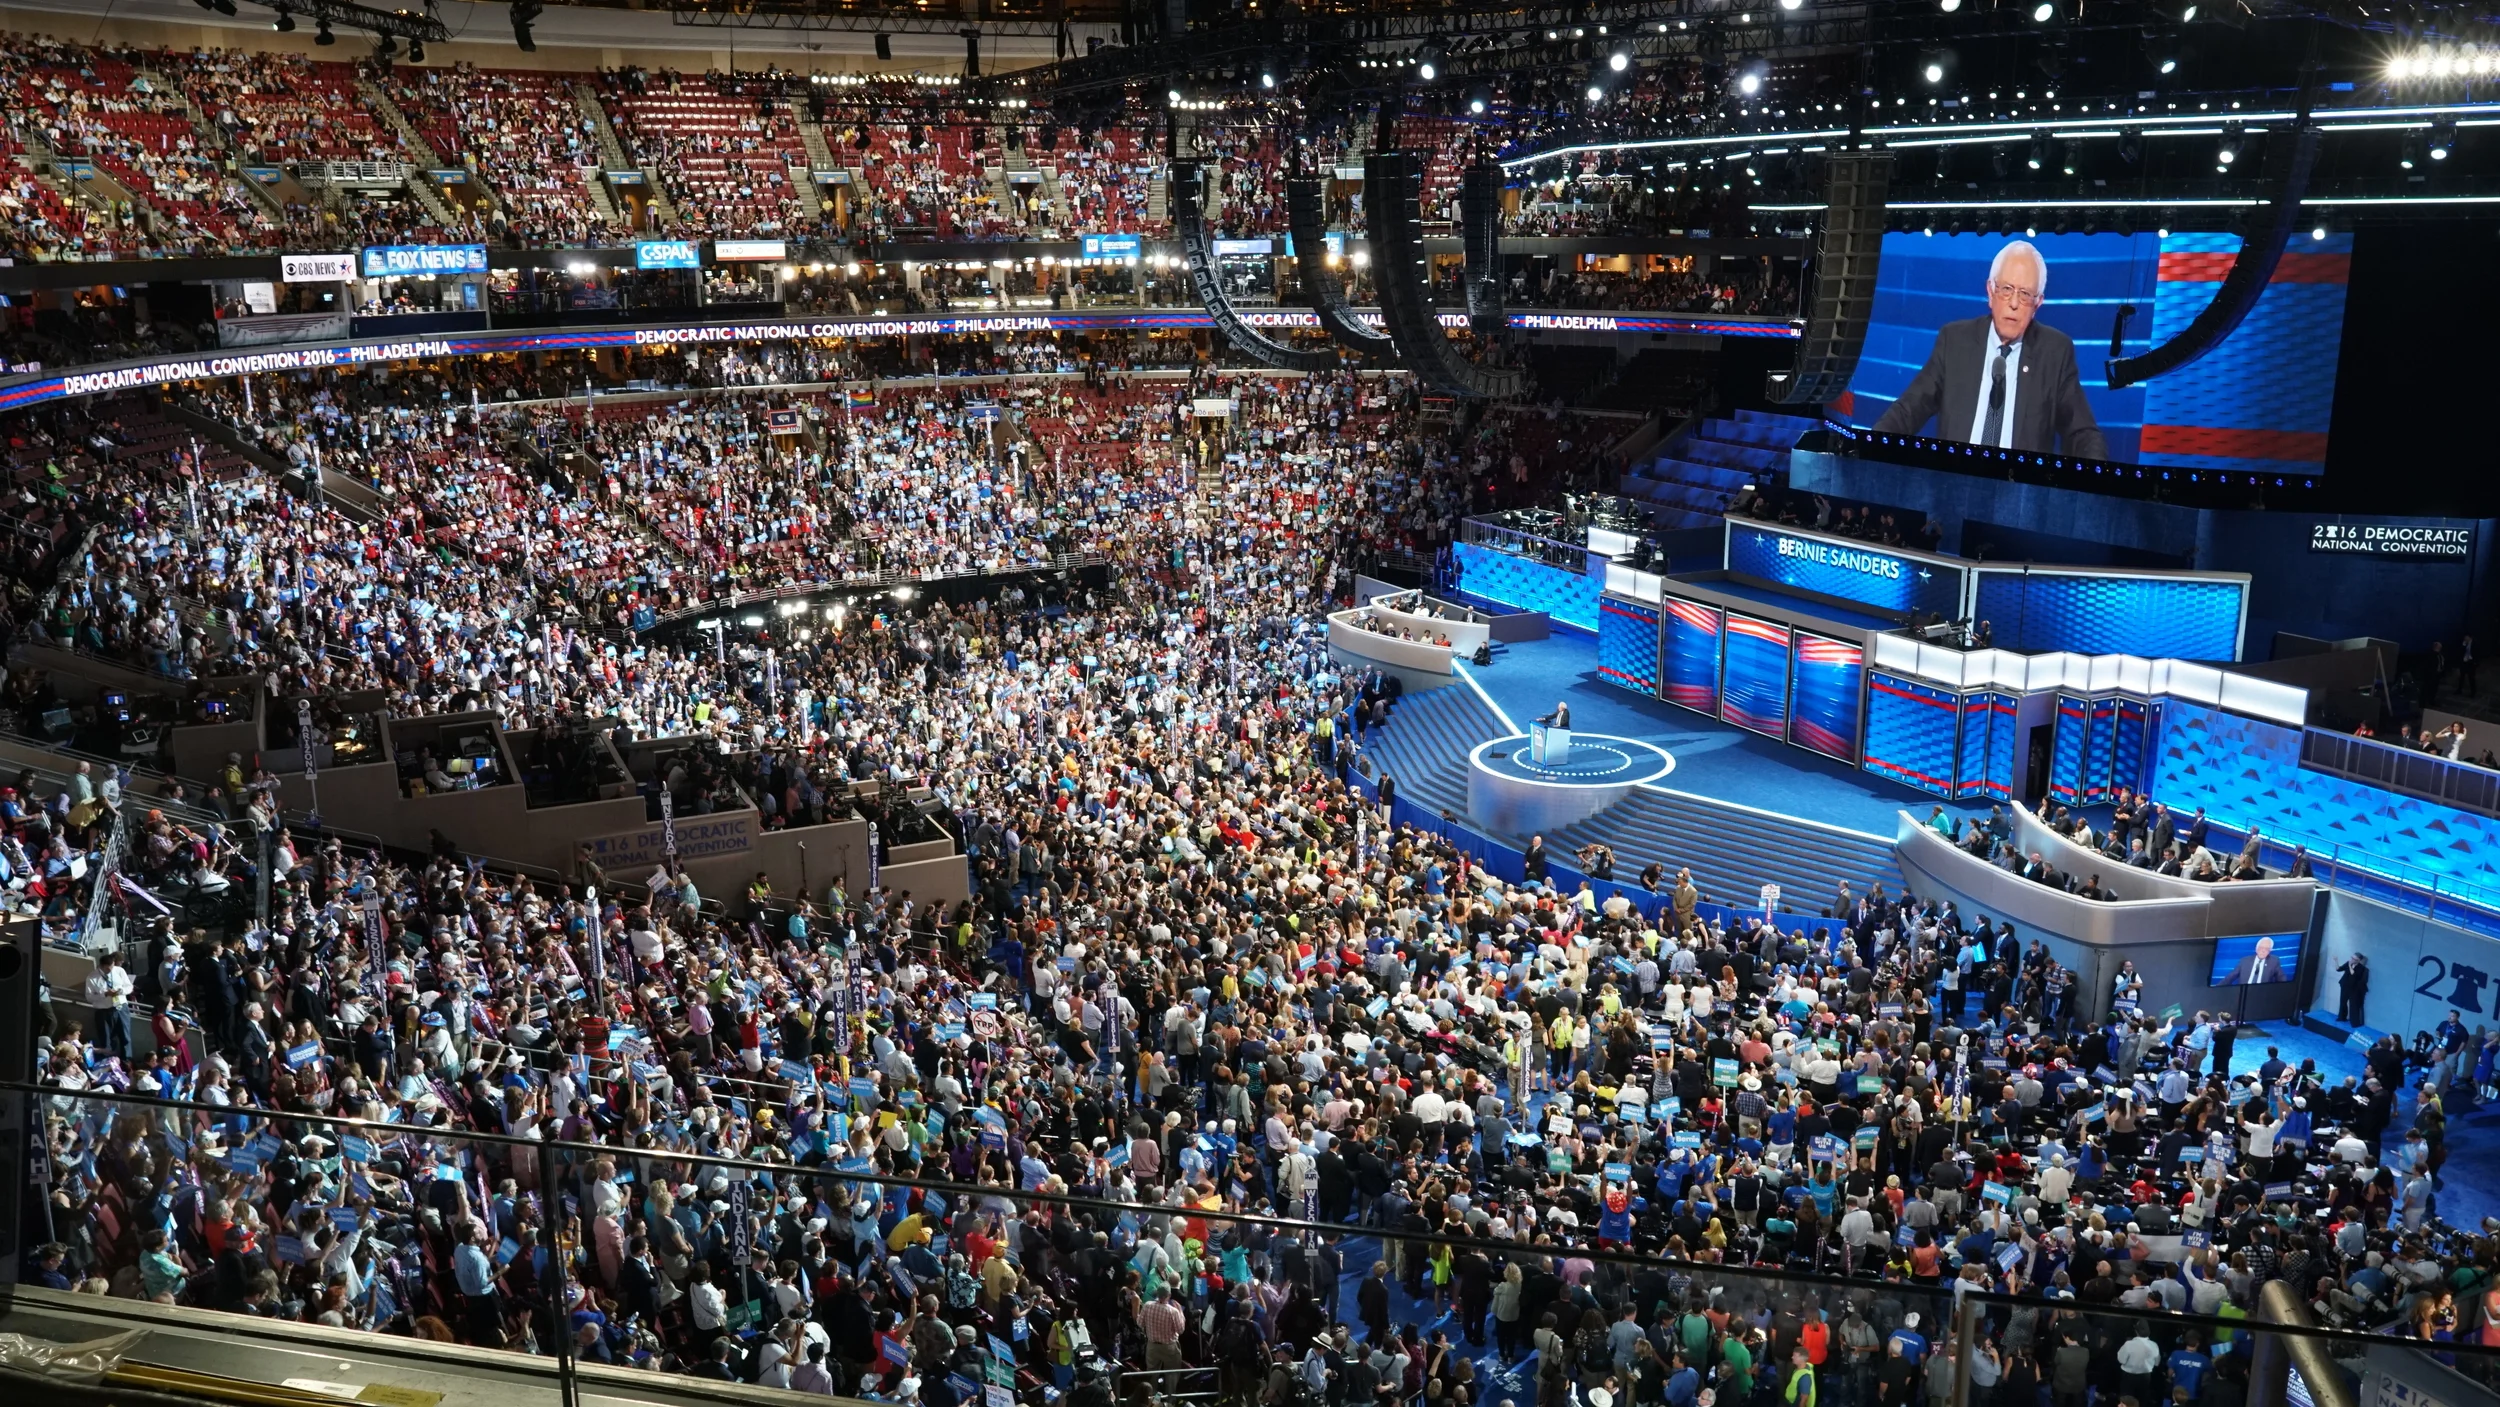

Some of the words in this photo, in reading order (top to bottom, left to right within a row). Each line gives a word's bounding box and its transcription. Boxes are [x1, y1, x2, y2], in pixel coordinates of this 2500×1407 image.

[386, 250, 419, 270] FOX
[420, 249, 466, 269] NEWS
[640, 244, 694, 261] C-SPAN
[298, 263, 313, 276] CBS
[314, 262, 336, 276] NEWS
[954, 317, 1052, 332] PHILADELPHIA
[1234, 314, 1313, 327] EMOCRATIC
[1524, 315, 1618, 331] PHILADELPHIA
[635, 327, 731, 345] DEMOCRATIC
[734, 323, 809, 340] NATIONAL
[811, 321, 907, 338] CONVENTION
[909, 320, 940, 334] 2016
[350, 340, 451, 363] PHILADELPHIA
[64, 368, 142, 395] DEMOCRATIC
[143, 359, 210, 384] NATIONAL
[211, 352, 300, 375] CONVENTION
[302, 349, 335, 366] 2016
[2365, 527, 2469, 543] DEMOCRATIC
[2312, 540, 2374, 551] NATIONAL
[2381, 542, 2467, 554] CONVENTION
[1778, 537, 1828, 564] BERNIE
[1830, 548, 1900, 579] SANDERS
[302, 725, 315, 775] ARIZONA
[663, 805, 676, 850] NEVADA
[594, 851, 649, 868] ATIONAL
[658, 836, 748, 859] CNVENTION
[1358, 848, 1366, 869] YORK
[367, 910, 382, 974] MISSOURI
[850, 960, 861, 1013] HAWAII
[836, 990, 844, 1010] NEW
[837, 1011, 846, 1047] MEXICO
[1715, 1061, 1738, 1070] Bernie
[1952, 1063, 1964, 1115] FLORIDA
[1661, 1101, 1680, 1110] Bernie
[2084, 1107, 2104, 1118] Bernie
[1551, 1121, 1568, 1129] trumps
[1855, 1129, 1878, 1137] Bernie
[983, 1132, 1001, 1141] Bernie
[1675, 1134, 1700, 1143] Bernie
[1106, 1149, 1126, 1161] Bernie
[842, 1161, 870, 1173] Bernie
[1604, 1166, 1630, 1176] Bernie
[1983, 1184, 2010, 1200] Bernie
[731, 1181, 748, 1257] INDIANA
[2188, 1235, 2205, 1243] WITH
[885, 1344, 907, 1361] Bernie
[951, 1376, 976, 1392] Bernie
